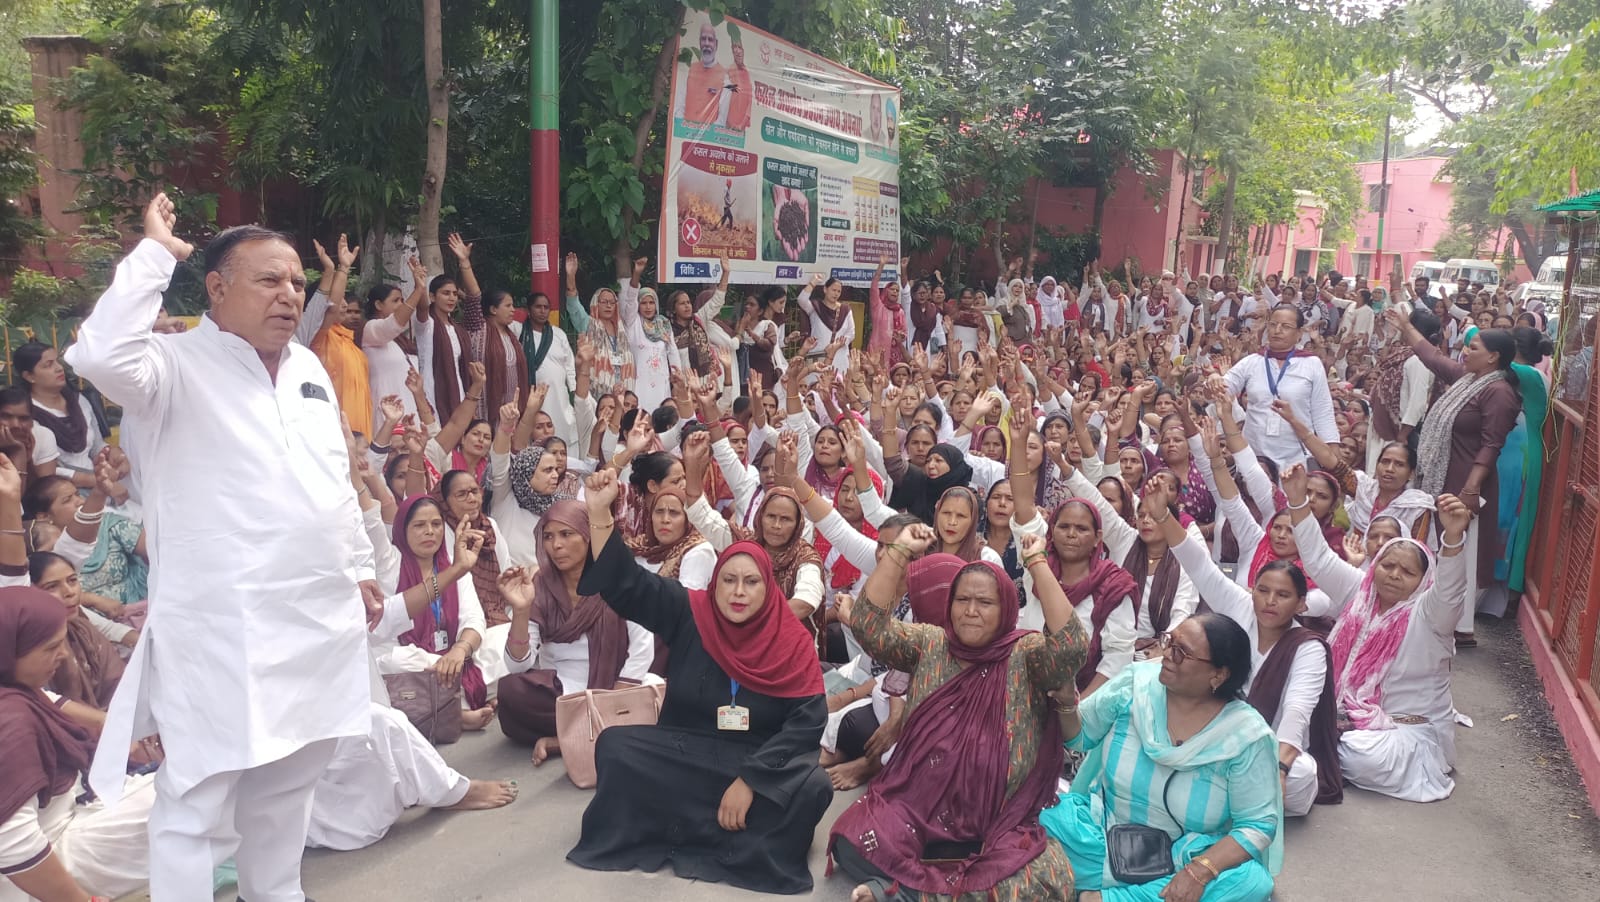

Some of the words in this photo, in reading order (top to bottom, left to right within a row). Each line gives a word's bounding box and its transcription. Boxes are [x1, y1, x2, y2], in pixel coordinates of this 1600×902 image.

[727, 150, 735, 162] को
[709, 160, 715, 171] से
[715, 163, 736, 175] नुकसान
[680, 264, 695, 275] विधि
